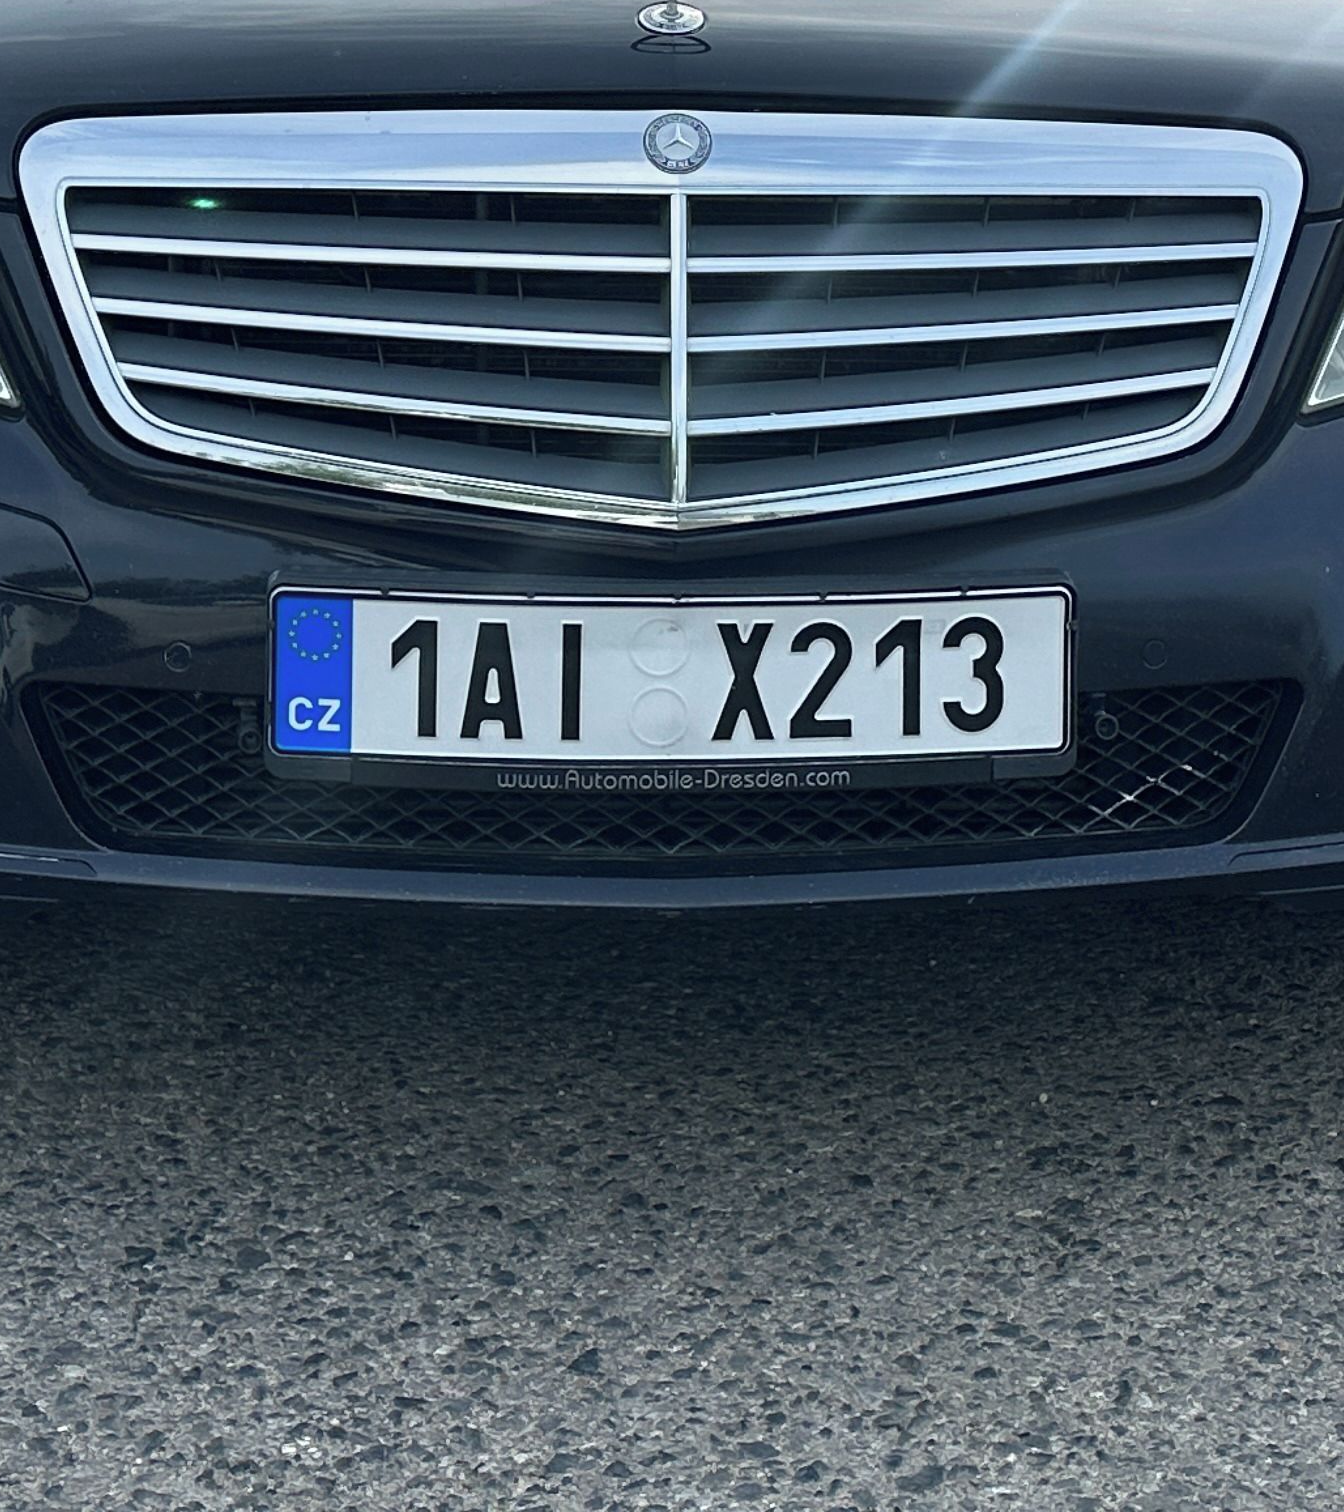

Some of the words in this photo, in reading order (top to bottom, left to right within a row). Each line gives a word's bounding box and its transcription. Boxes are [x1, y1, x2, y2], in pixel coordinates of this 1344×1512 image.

[391, 619, 583, 741] 1AI
[711, 616, 1005, 741] X213
[288, 696, 341, 732] CZ
[497, 768, 851, 789] www.Automobile-Dresden.com
